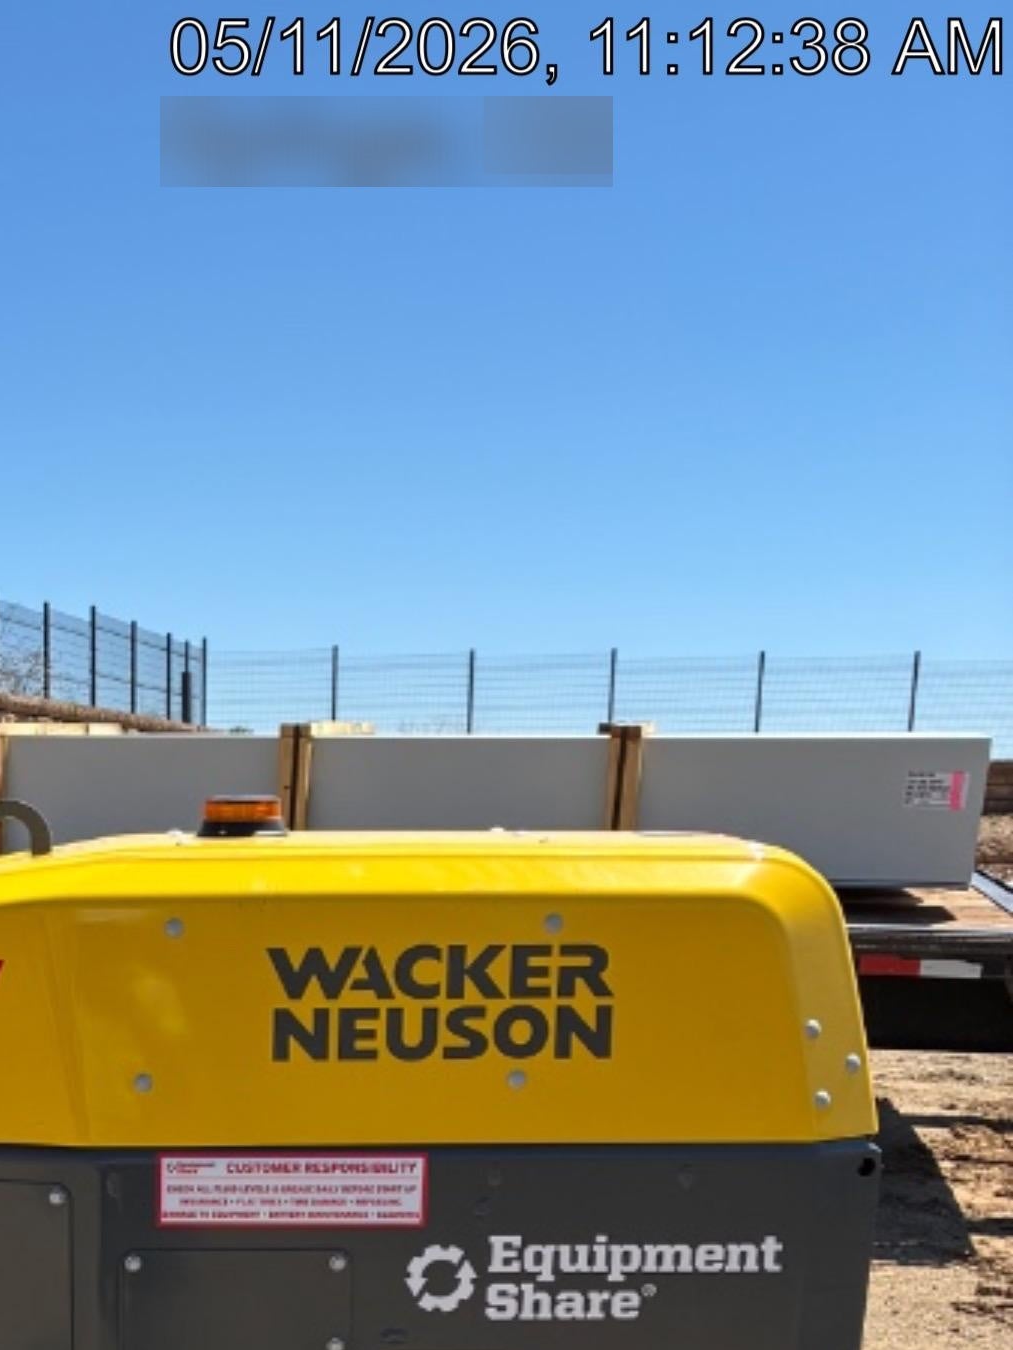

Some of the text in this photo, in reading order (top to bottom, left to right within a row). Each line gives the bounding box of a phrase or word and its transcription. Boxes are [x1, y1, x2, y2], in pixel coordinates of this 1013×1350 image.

[266, 944, 615, 1001] WACKER
[271, 1004, 614, 1062] NEUSON
[226, 1162, 301, 1174] CUSTOMER
[304, 1162, 417, 1174] RESPONSIBILITY
[488, 1234, 784, 1282] Equipment
